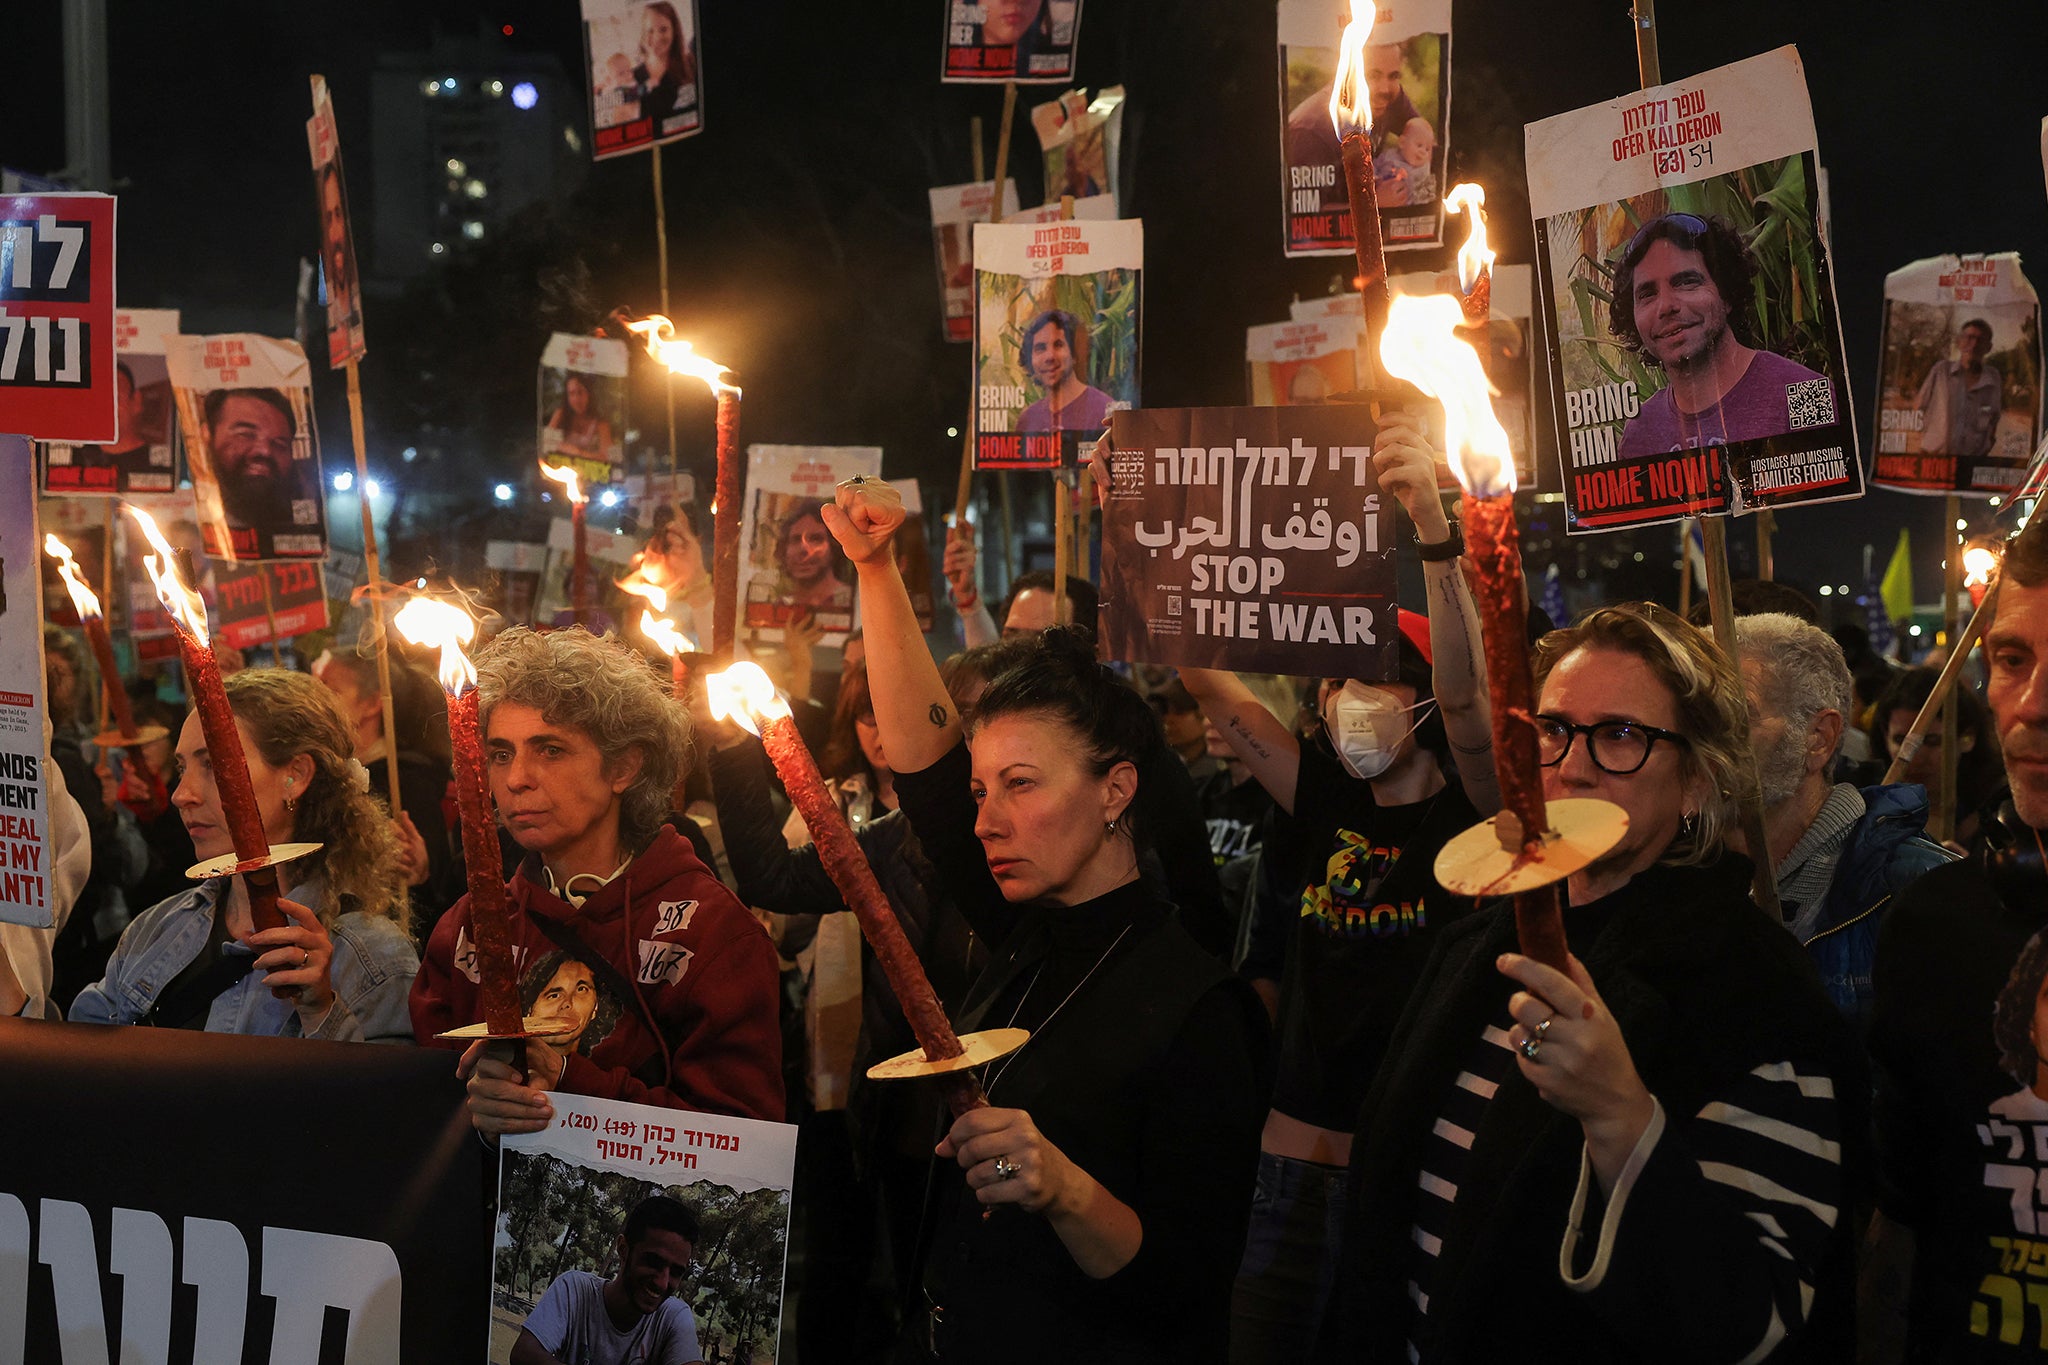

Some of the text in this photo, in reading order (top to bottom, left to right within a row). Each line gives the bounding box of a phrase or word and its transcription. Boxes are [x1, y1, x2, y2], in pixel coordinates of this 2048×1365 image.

[1621, 89, 1706, 136] עופר קלדרון
[1612, 111, 1722, 162] OFER KALDERON
[1688, 140, 1714, 168] 54
[1290, 164, 1336, 188] BRING
[1291, 188, 1321, 214] HIM
[1290, 215, 1334, 240] HOME
[979, 386, 1026, 409] BRING
[1564, 380, 1640, 429] BRING
[979, 409, 1009, 433] HIM
[979, 435, 1022, 460] HOME
[1154, 437, 1371, 487] די למלחמה
[1568, 425, 1618, 469] HIM
[1750, 446, 1843, 473] HOSTAGES AND MISSING
[1574, 448, 1723, 513] HOME NOW!
[1752, 469, 1802, 491] FAMILIES
[1261, 494, 1381, 568] أوقف
[1190, 553, 1286, 595] STOP
[1190, 597, 1377, 646] THE WAR
[11, 842, 42, 872] MY
[0, 871, 44, 908] NT!
[656, 900, 692, 933] 98
[561, 1111, 740, 1152] נמרוד כהן (19) (20),
[597, 1138, 698, 1170] חייל, חטוף
